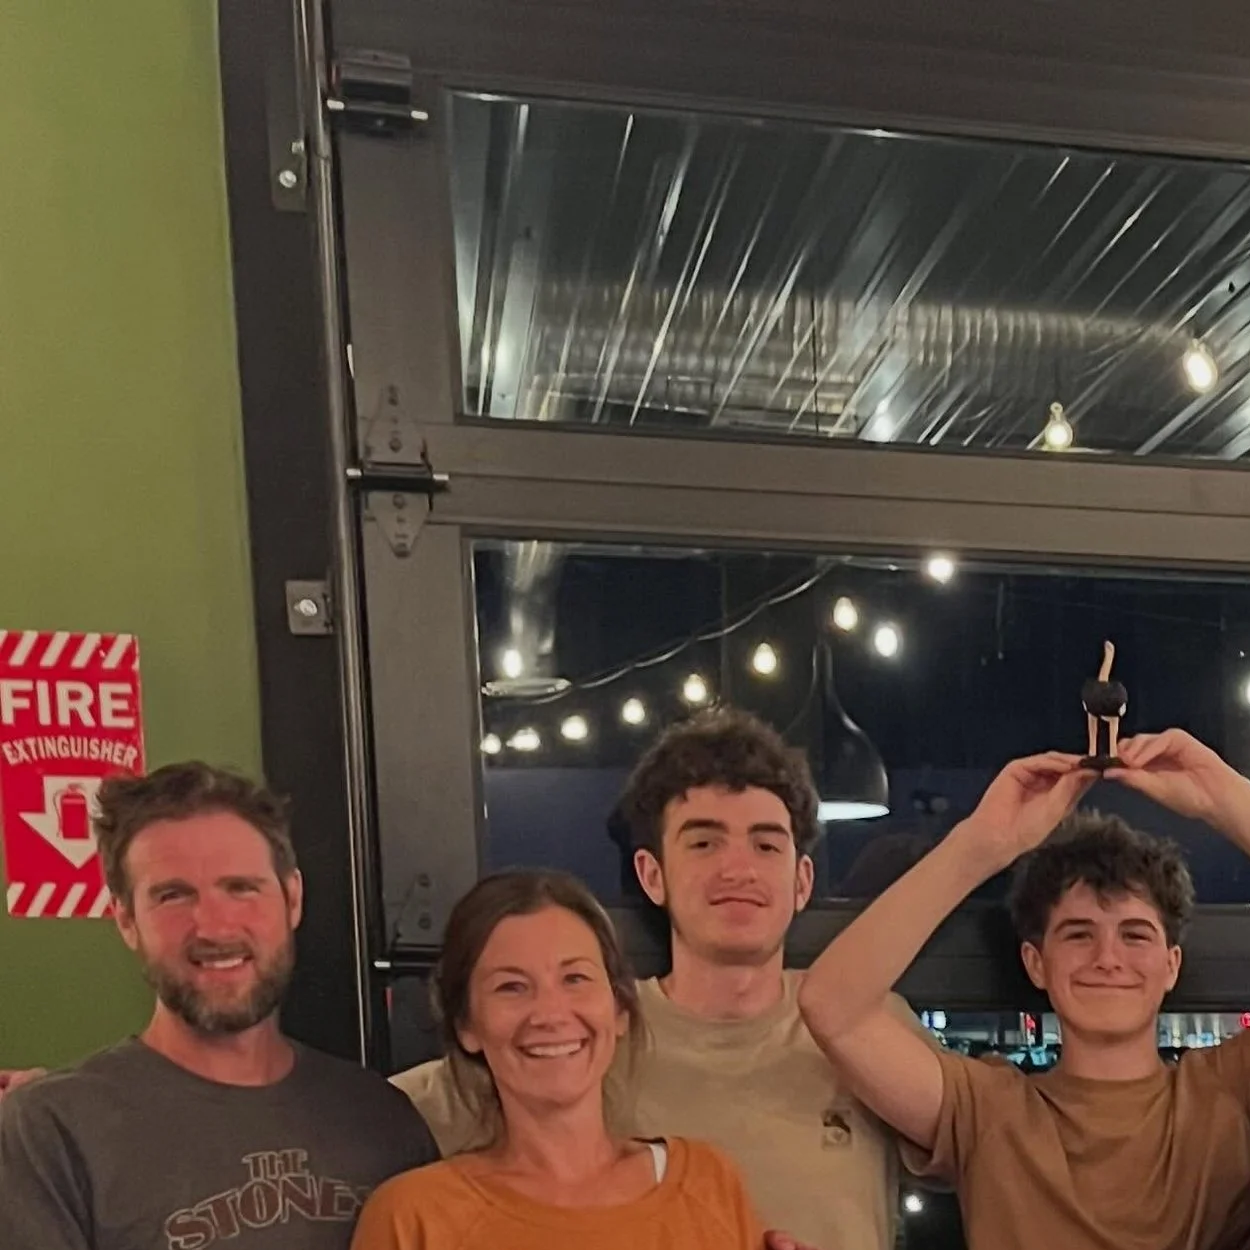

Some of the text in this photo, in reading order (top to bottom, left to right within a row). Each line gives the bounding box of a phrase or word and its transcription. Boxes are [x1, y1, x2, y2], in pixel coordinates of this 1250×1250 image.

[0, 678, 136, 728] FIRE
[2, 736, 138, 768] EXTINGUISHER
[241, 1149, 309, 1180] THE
